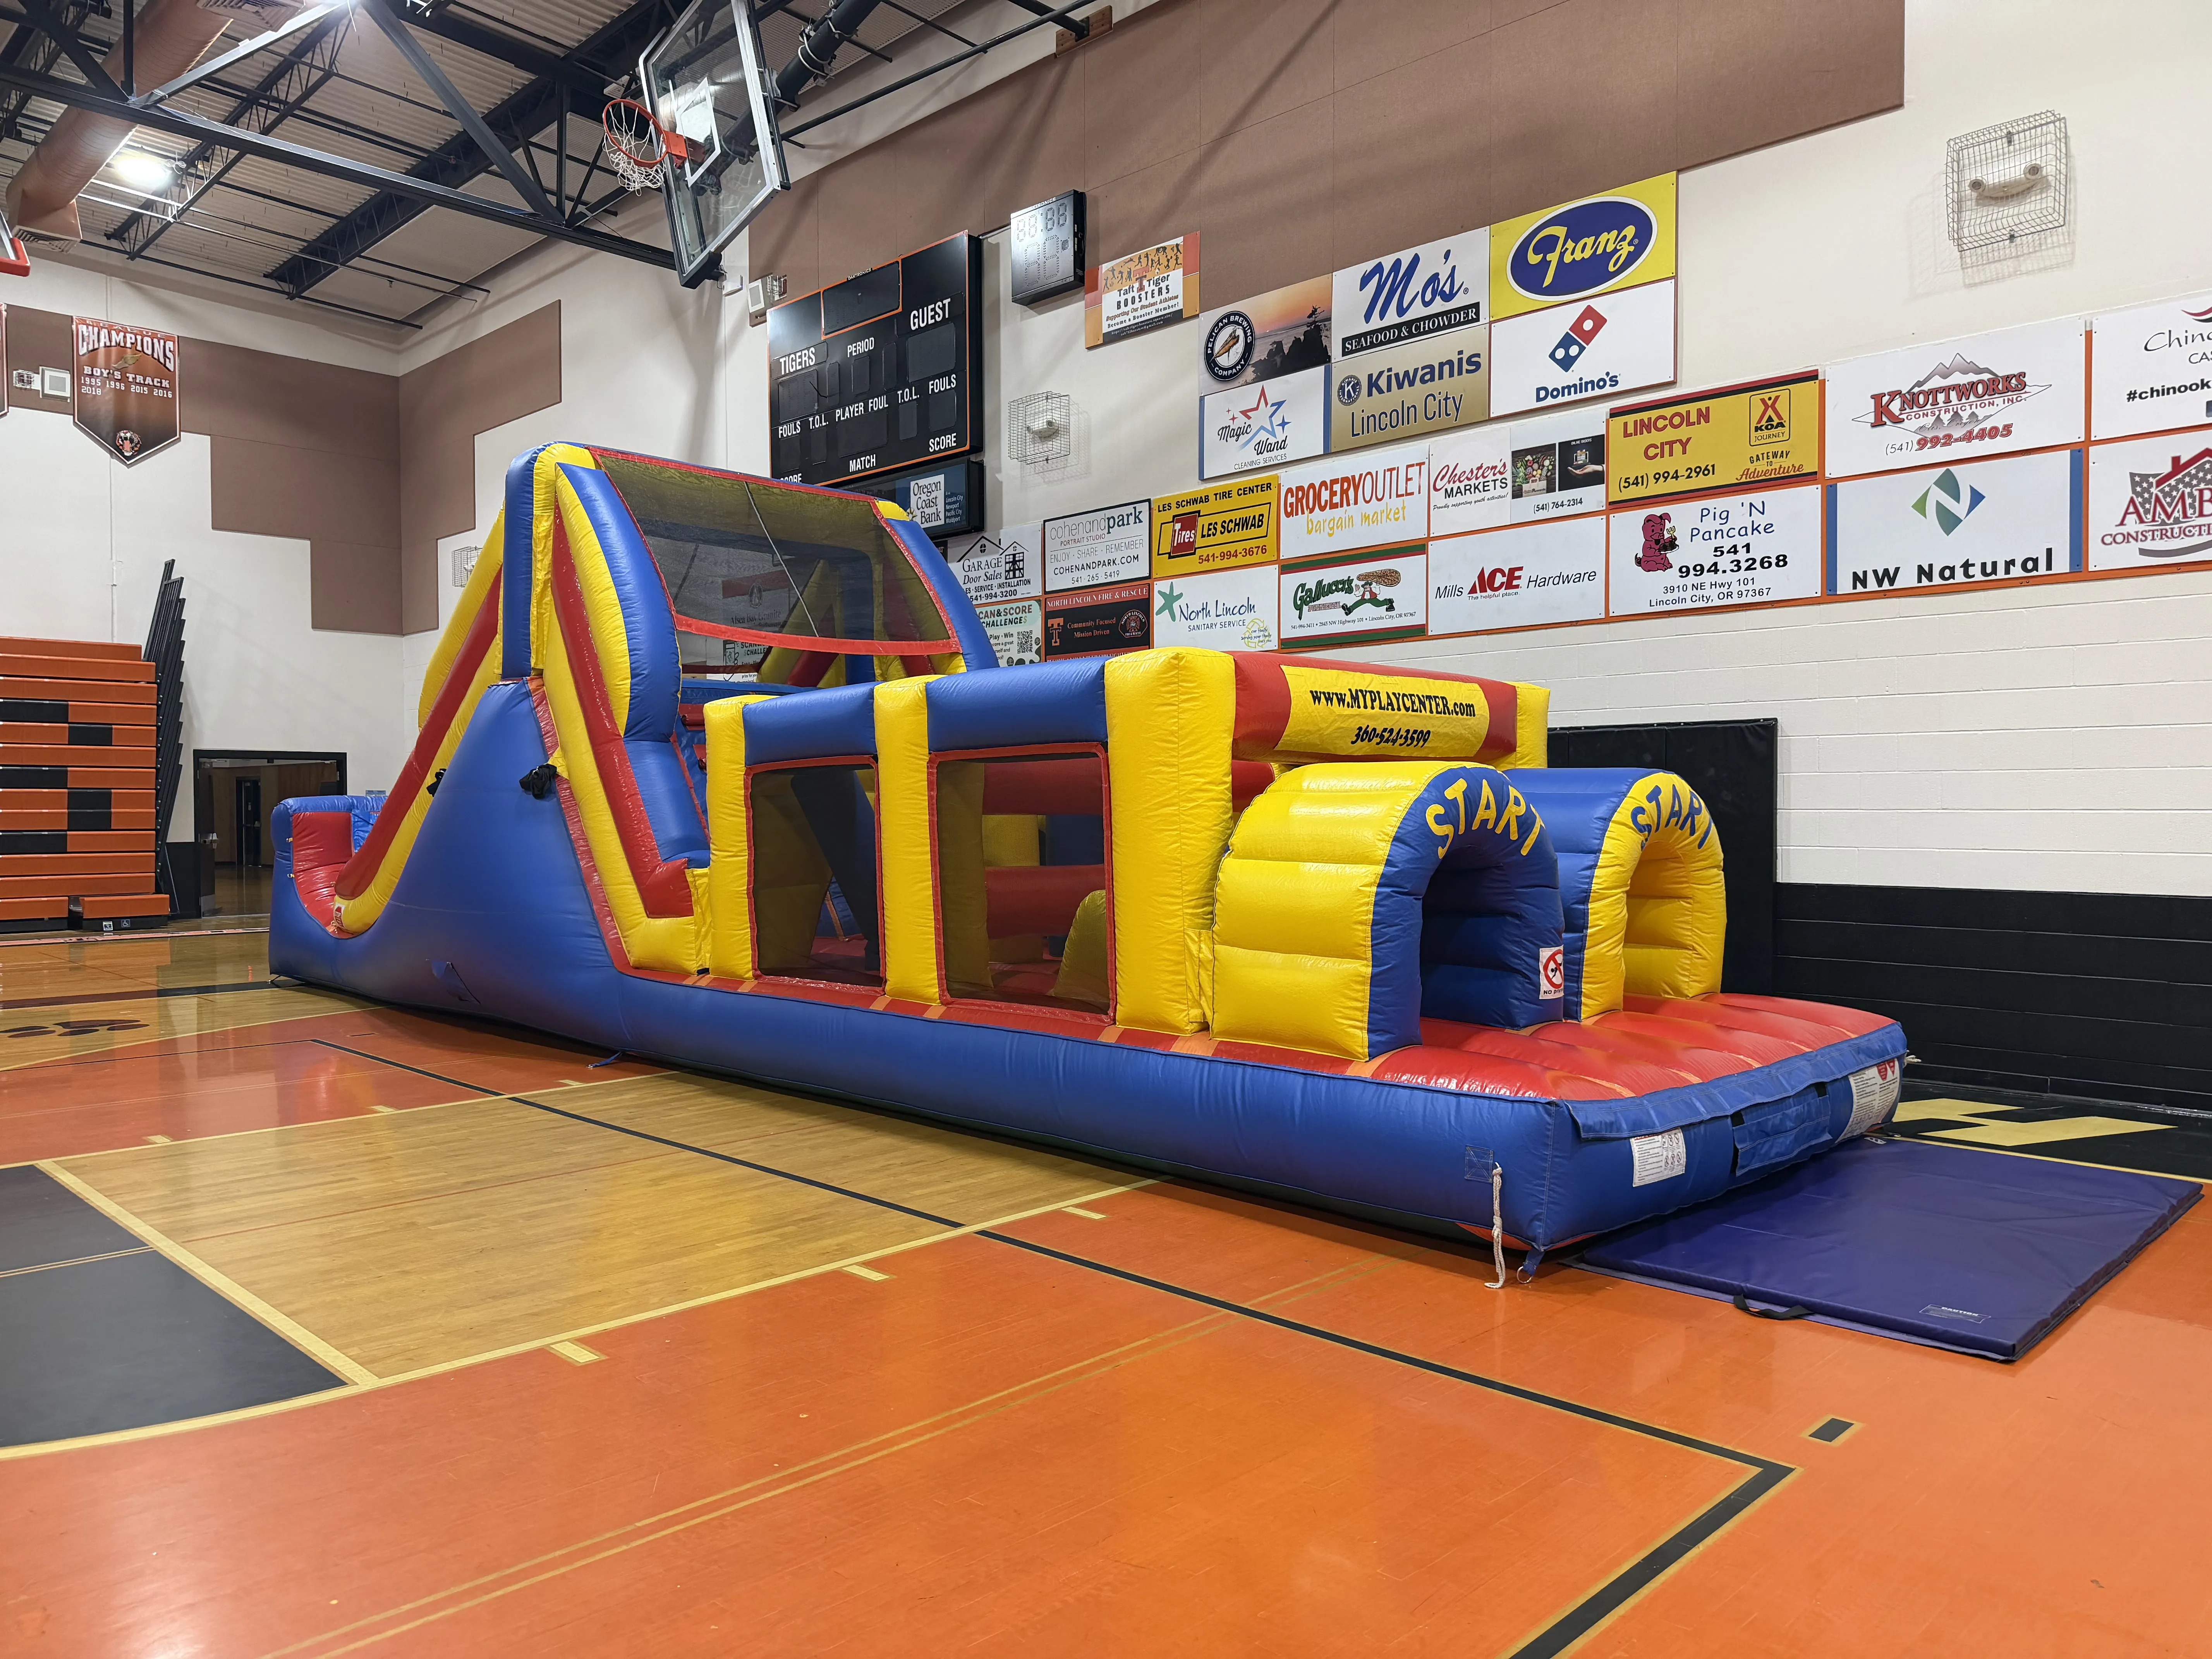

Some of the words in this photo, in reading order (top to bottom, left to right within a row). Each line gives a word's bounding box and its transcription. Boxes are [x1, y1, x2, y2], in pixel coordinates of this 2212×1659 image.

[1527, 225, 1635, 288] Franz
[848, 268, 871, 280] DAKTRONICS
[1118, 285, 1135, 297] Taft
[1147, 274, 1170, 287] Tiger
[1117, 284, 1170, 310] BOOSTERS
[1359, 249, 1464, 324] Mo's
[910, 298, 951, 330] GUEST
[1106, 310, 1129, 322] Supporting
[1140, 301, 1158, 311] Student
[1108, 319, 1127, 328] Become
[1133, 311, 1153, 321] Booster
[1155, 302, 1179, 314] Member!
[1207, 318, 1228, 353] PELICAN
[1230, 316, 1252, 343] BREWING
[1345, 328, 1398, 352] SEAFOOD
[1401, 326, 1409, 337] &
[1412, 307, 1476, 334] CHOWDER
[78, 324, 174, 372] CHAMPIONS
[848, 337, 874, 357] PERIOD
[780, 347, 815, 374] TIGERS
[1214, 359, 1245, 376] COMPANY
[84, 366, 121, 380] BOY'S
[126, 373, 170, 388] TRACK
[1367, 350, 1482, 397] Kiwanis
[81, 376, 101, 386] 1995
[106, 381, 125, 390] 1996
[131, 385, 148, 393] 2015
[153, 389, 172, 398] 2016
[81, 386, 101, 395] 2018
[1535, 371, 1619, 403] Domino's
[779, 421, 800, 438] FOULS
[809, 414, 828, 429] T.O.L.
[836, 402, 864, 421] PLAYER
[869, 395, 888, 412] FOUL
[897, 386, 919, 404] T.O.L.
[929, 374, 956, 394] FOULS
[1870, 372, 2026, 428] KNOTTWORKS
[1906, 401, 1998, 421] CONSTRUCTION,
[2003, 395, 2027, 405] INC.
[1352, 401, 1417, 438] Lincoln
[1424, 390, 1463, 423] City
[1623, 406, 1710, 438] LINCOLN
[1218, 422, 1252, 442] Magic
[1754, 421, 1786, 432] KOA
[1754, 431, 1786, 442] JOURNEY
[1254, 435, 1288, 455] Wand
[1644, 437, 1692, 460] CITY
[1886, 440, 1913, 455] (541)
[1915, 423, 2013, 451] 992-4405
[850, 454, 876, 472] MATCH
[929, 433, 957, 452] SCORE
[1234, 459, 1260, 470] CLEANING
[1263, 453, 1286, 464] SERVICES
[1749, 450, 1790, 464] GATEWAY
[1433, 458, 1508, 492] Chester's
[1619, 473, 1649, 493] (541)
[1653, 464, 1715, 484] 994-2961
[1736, 464, 1804, 481] Adventure
[913, 481, 941, 497] Oregon
[1158, 503, 1172, 513] LES
[1176, 495, 1209, 508] SCHWAB
[1214, 490, 1232, 501] TIRE
[1237, 483, 1272, 496] CENTER
[1444, 477, 1508, 499] MARKETS
[917, 495, 938, 510] Coast
[1534, 502, 1549, 514] (541)
[1551, 498, 1583, 509] 764-2314
[1700, 507, 1729, 525] Pig
[1741, 501, 1765, 517] 'N
[921, 508, 941, 524] Bank
[1050, 507, 1143, 540] cohenandpark
[1201, 521, 1218, 538] LES
[1220, 514, 1264, 535] SCHWAB
[1307, 509, 1354, 537] bargain
[1361, 499, 1406, 527] market
[1061, 537, 1084, 546] PORTRAIT
[1087, 533, 1105, 542] STUDIO
[1174, 523, 1195, 546] Tires
[1691, 520, 1774, 542] Pancake
[1050, 552, 1070, 563] ENJOY
[1077, 547, 1098, 558] SHARE
[1106, 539, 1143, 554] REMEMBER
[1198, 544, 1267, 564] 541-994-3676
[1713, 543, 1750, 557] 541
[963, 557, 1002, 572] GARAGE
[1054, 554, 1139, 575] COHENANDPARK.COM
[1087, 574, 1099, 582] 265
[1104, 570, 1120, 579] 5419
[1678, 555, 1788, 578] 994.3268
[1852, 567, 1900, 590] NW
[1917, 548, 2052, 584] Natural
[963, 575, 981, 585] Door
[984, 570, 1002, 582] Sales
[975, 584, 993, 593] SERVICE
[997, 579, 1030, 589] INSTALLATION
[1435, 584, 1463, 599] Mills
[1467, 566, 1523, 595] ACE
[1527, 570, 1596, 589] Hardware
[1663, 584, 1687, 594] 3910
[1692, 582, 1706, 591] NE
[1710, 580, 1732, 589] Hwy
[1736, 577, 1754, 586] 101
[970, 589, 1017, 602] 541-994-3200
[1070, 595, 1096, 605] LINCOLN
[1099, 592, 1113, 601] FIRE
[1122, 588, 1147, 597] RESCUE
[1650, 596, 1686, 607] Lincoln
[1691, 594, 1713, 603] City,
[1717, 592, 1733, 600] OR
[1737, 587, 1771, 598] 97367
[1179, 602, 1211, 622] North
[1216, 596, 1256, 617] Lincoln
[1068, 621, 1095, 629] Community
[1188, 623, 1217, 632] SANITARY
[1220, 619, 1246, 629] SERVICE
[1310, 688, 1476, 718] www.MYPLAYCENTER.com
[1351, 725, 1431, 749] 360-524-3599
[1425, 778, 1546, 859] START
[1630, 784, 1713, 851] START
[1942, 1307, 1978, 1316] CAUTION
